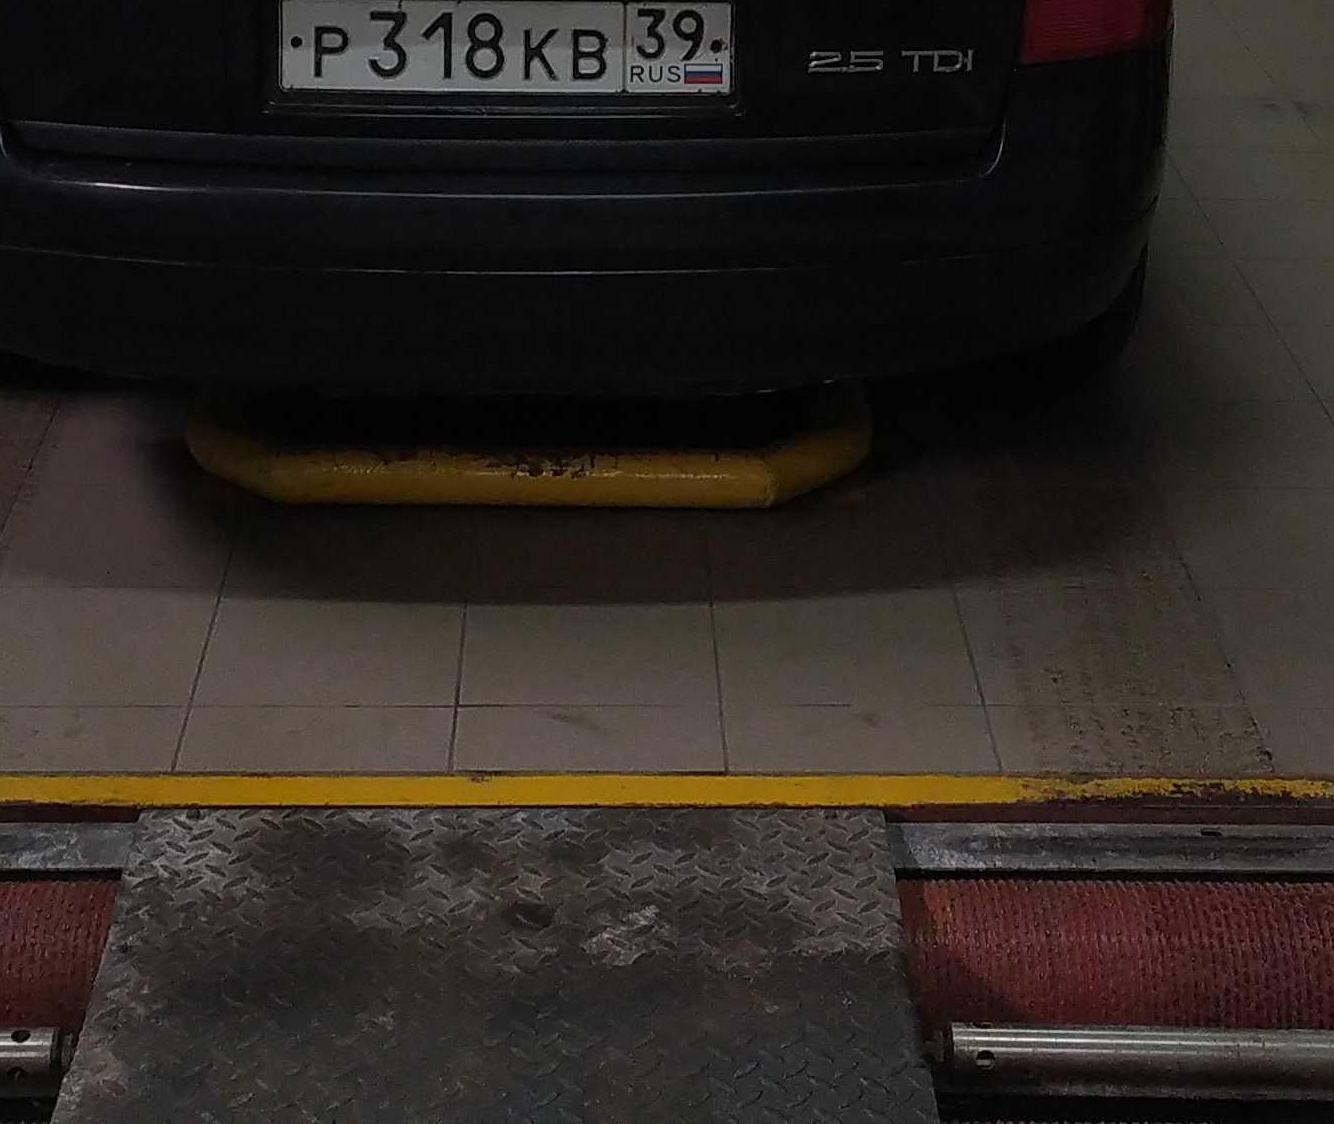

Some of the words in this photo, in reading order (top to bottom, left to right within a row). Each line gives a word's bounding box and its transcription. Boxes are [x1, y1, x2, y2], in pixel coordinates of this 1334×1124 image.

[313, 10, 609, 80] P318KB
[636, 7, 705, 62] 39
[901, 49, 974, 73] TDI
[630, 64, 681, 83] RUS
